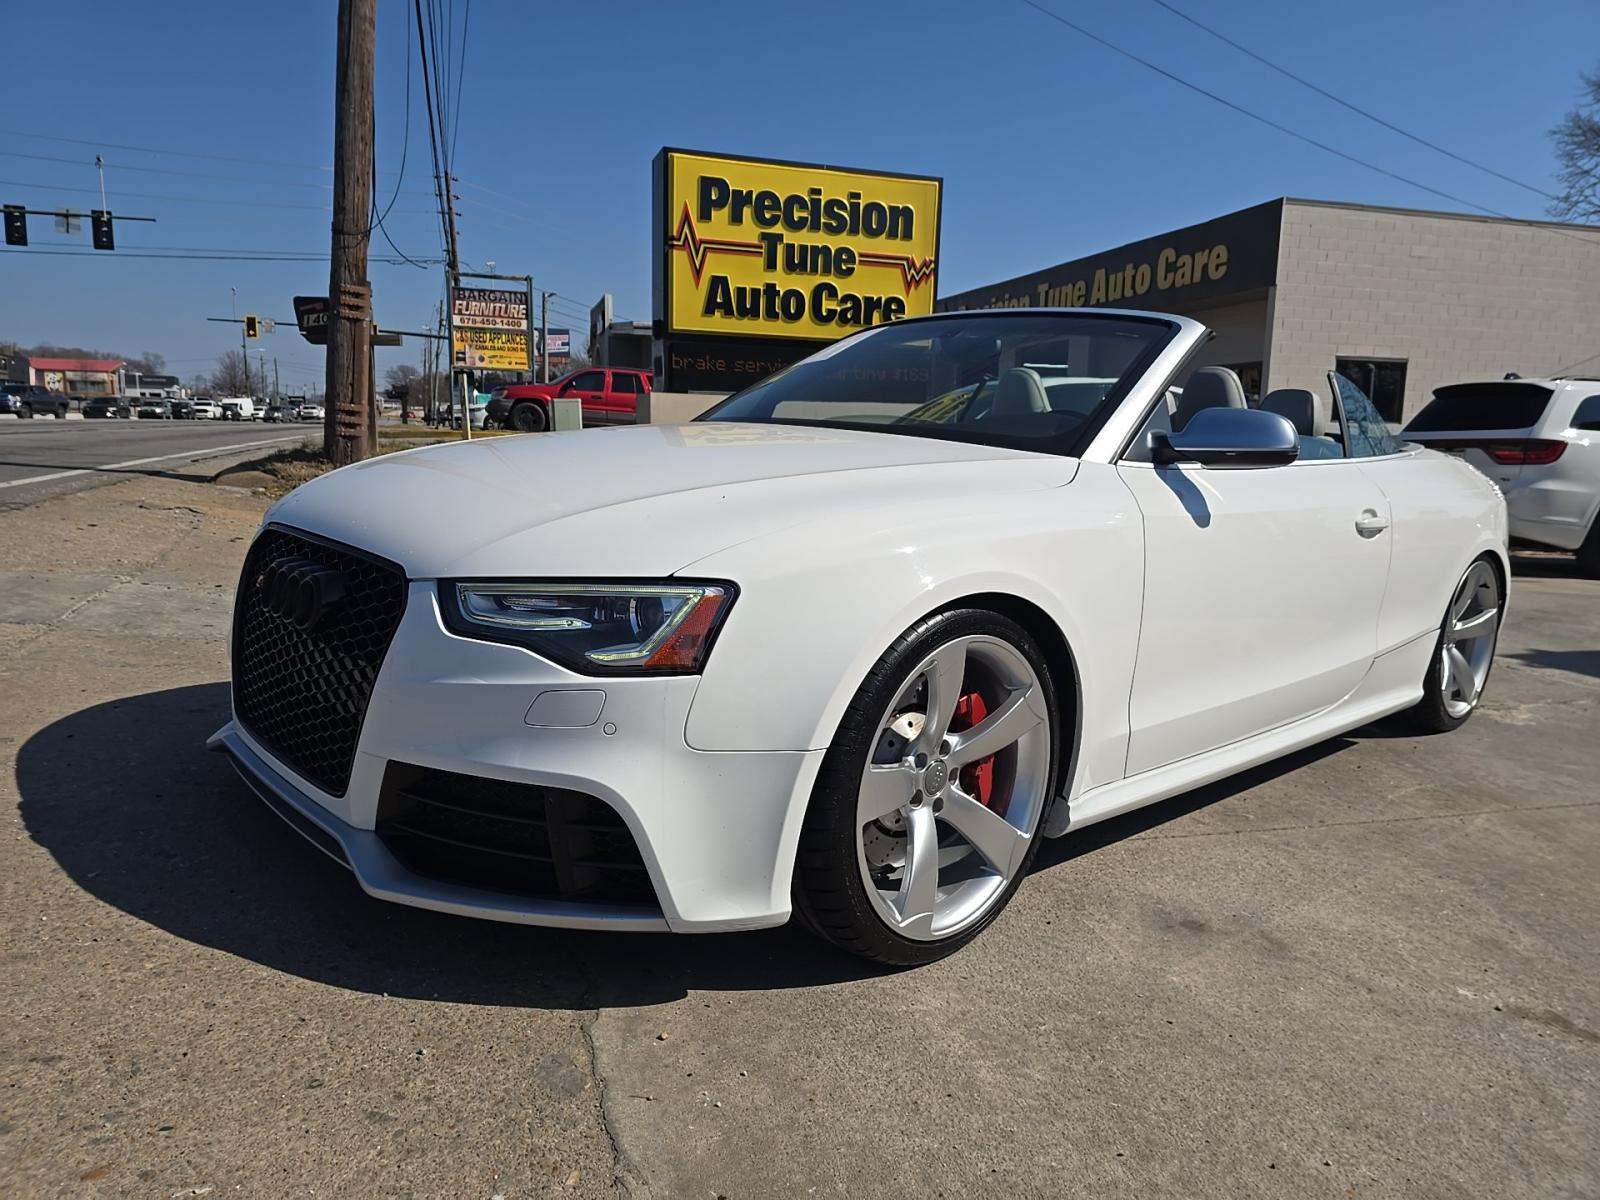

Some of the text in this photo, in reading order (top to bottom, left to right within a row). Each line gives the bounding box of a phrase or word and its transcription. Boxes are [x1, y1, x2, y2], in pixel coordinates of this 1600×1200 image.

[697, 175, 914, 241] Precision
[758, 231, 857, 278] Tune
[1036, 279, 1087, 308] Tune
[1090, 262, 1151, 306] Auto
[1156, 245, 1229, 290] Care
[458, 289, 527, 304] BARGAIN
[701, 275, 906, 327] Auto Care
[454, 300, 527, 318] FURNITURE
[459, 316, 522, 328] 678-450-1400
[470, 330, 487, 344] USED
[489, 332, 528, 346] APPLIANCES
[671, 353, 727, 372] brake
[733, 357, 790, 374] servi
